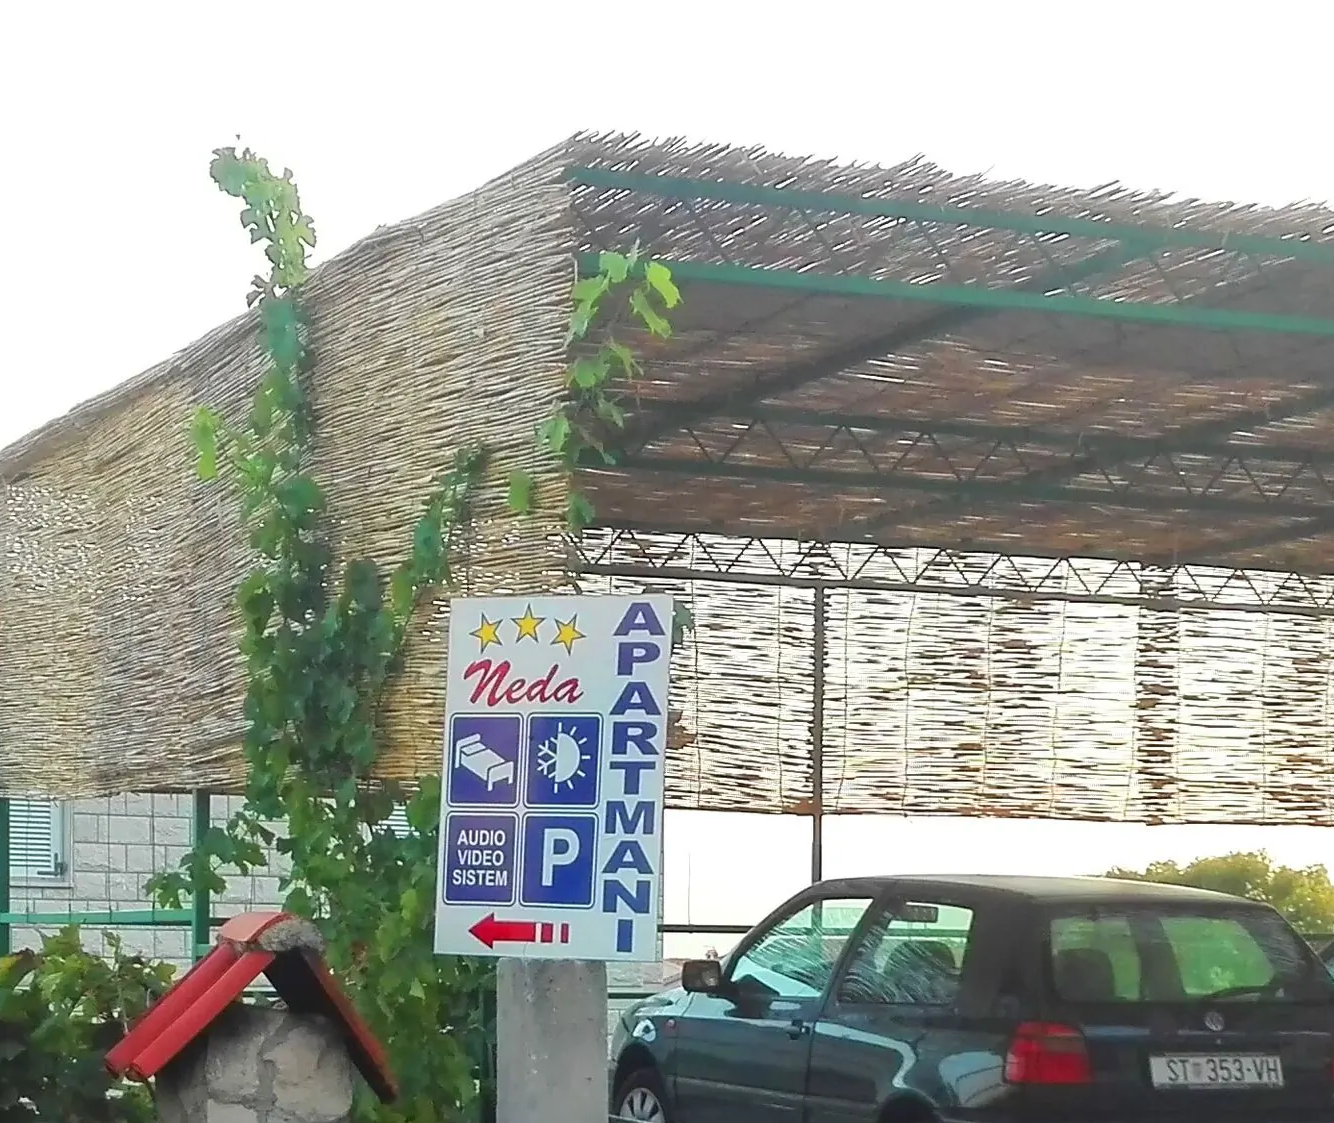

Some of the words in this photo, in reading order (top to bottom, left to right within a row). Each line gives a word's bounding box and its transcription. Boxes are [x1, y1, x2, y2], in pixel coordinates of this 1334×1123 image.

[463, 658, 585, 707] Neda
[601, 601, 666, 953] APARTMANI
[456, 829, 506, 846] AUDIO
[457, 849, 505, 866] VIDEO
[541, 828, 581, 887] P
[452, 869, 508, 887] SISTEM
